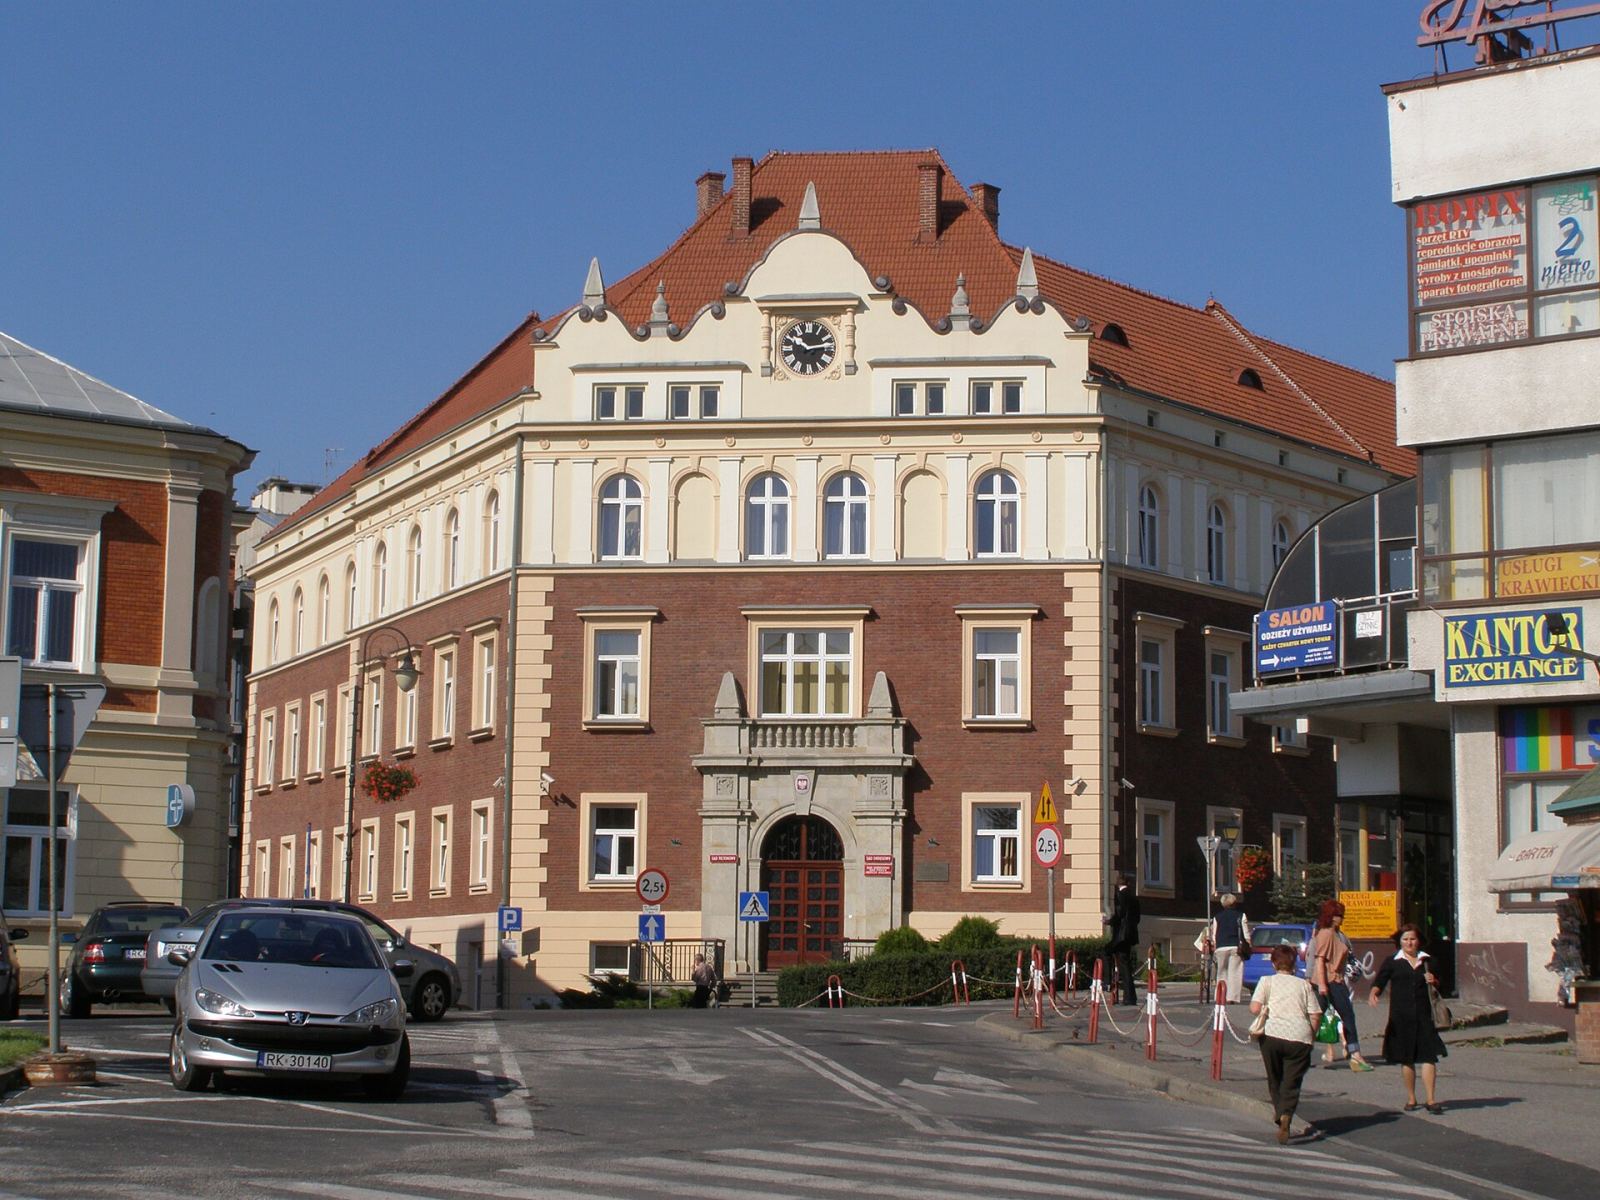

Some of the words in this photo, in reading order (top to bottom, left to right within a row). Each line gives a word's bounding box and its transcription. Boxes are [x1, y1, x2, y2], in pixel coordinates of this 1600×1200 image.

[1416, 241, 1477, 257] reprodukcje
[1478, 235, 1520, 248] obrazów
[1555, 217, 1580, 257] 2
[1417, 272, 1452, 286] wyroby
[1417, 285, 1455, 299] aparaty
[1456, 276, 1523, 293] fotograficzne
[1431, 304, 1515, 329] STOISKA
[1420, 320, 1527, 349] PRYWATNE
[1502, 556, 1562, 577] USŁUGI
[1268, 606, 1324, 628] SALON
[1261, 628, 1291, 641] ODZIEŻY
[1293, 622, 1332, 636] UŻYWANEJ
[1446, 612, 1582, 660] KANTOR
[1449, 657, 1580, 682] EXCHANGE
[503, 910, 518, 929] P
[266, 1053, 285, 1066] RK
[290, 1055, 329, 1069] 30140
